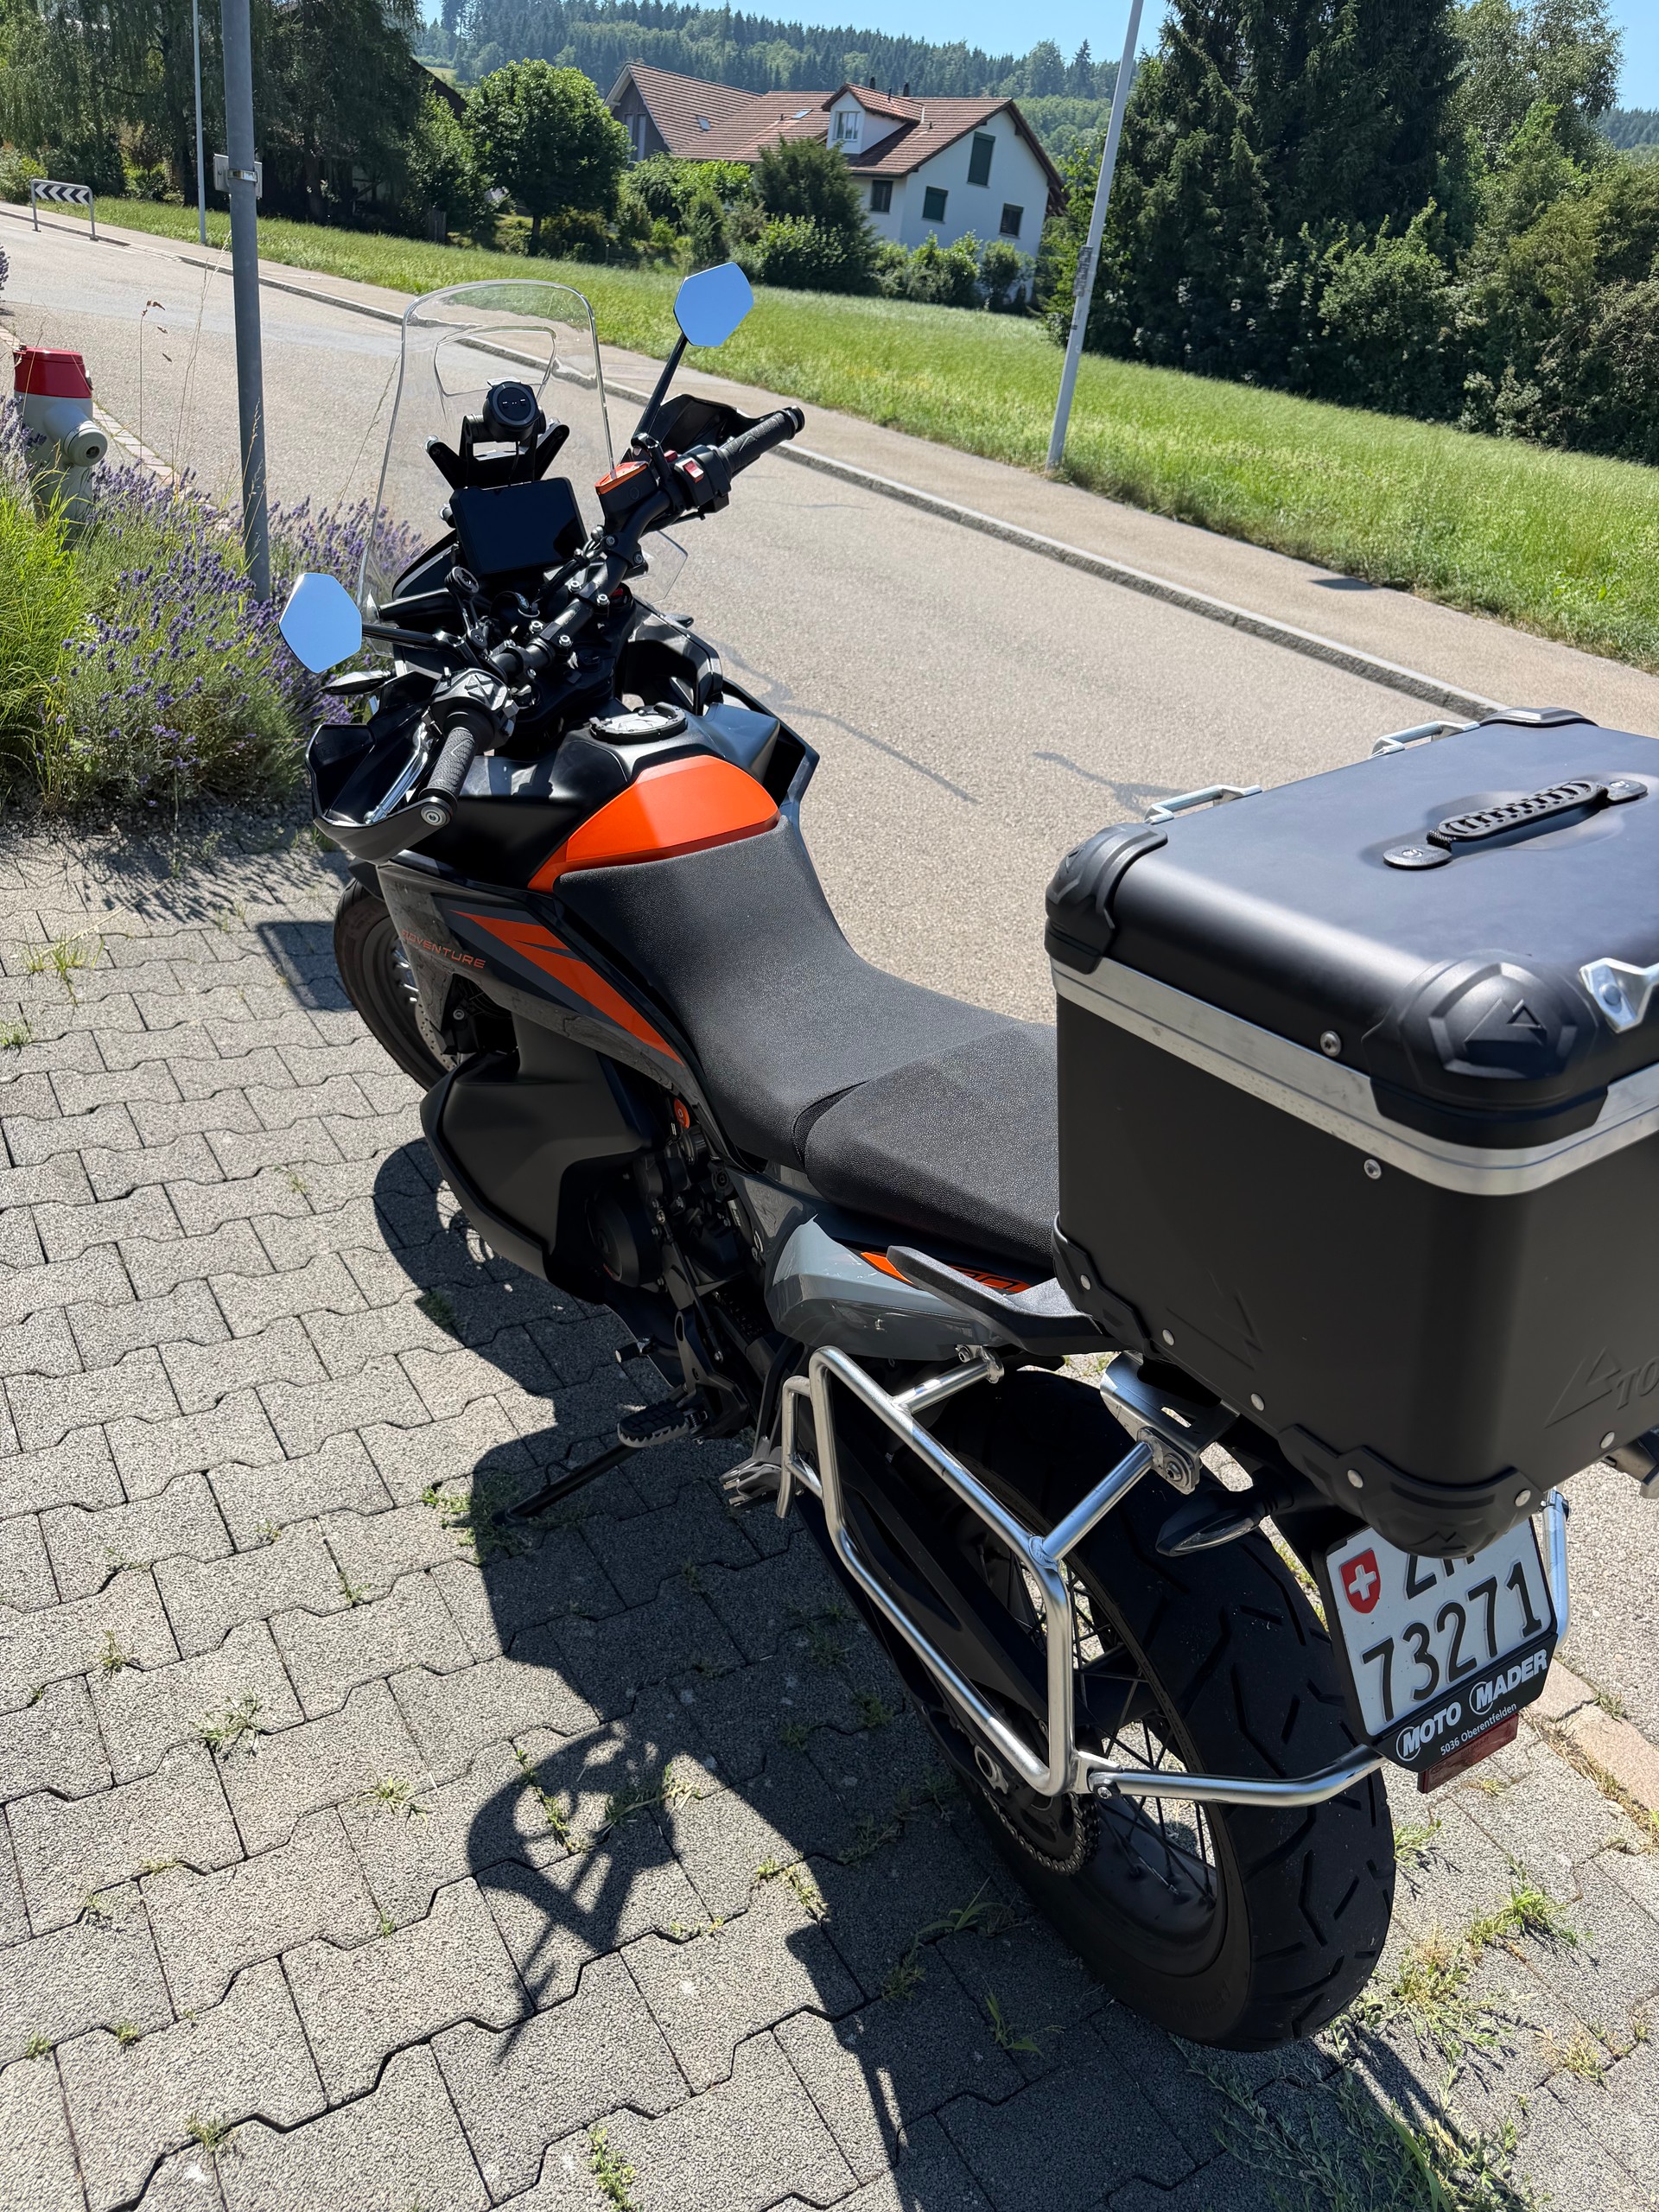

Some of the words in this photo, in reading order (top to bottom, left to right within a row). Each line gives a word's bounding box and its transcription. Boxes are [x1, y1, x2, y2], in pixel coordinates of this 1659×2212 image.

[402, 929, 486, 969] ADVENTURE
[1362, 1561, 1542, 1723] 73271
[1398, 1701, 1462, 1759] MOTO
[1471, 1649, 1548, 1713] MADER
[1440, 1737, 1460, 1756] 5036
[1460, 1703, 1517, 1743] Oberentfelden
